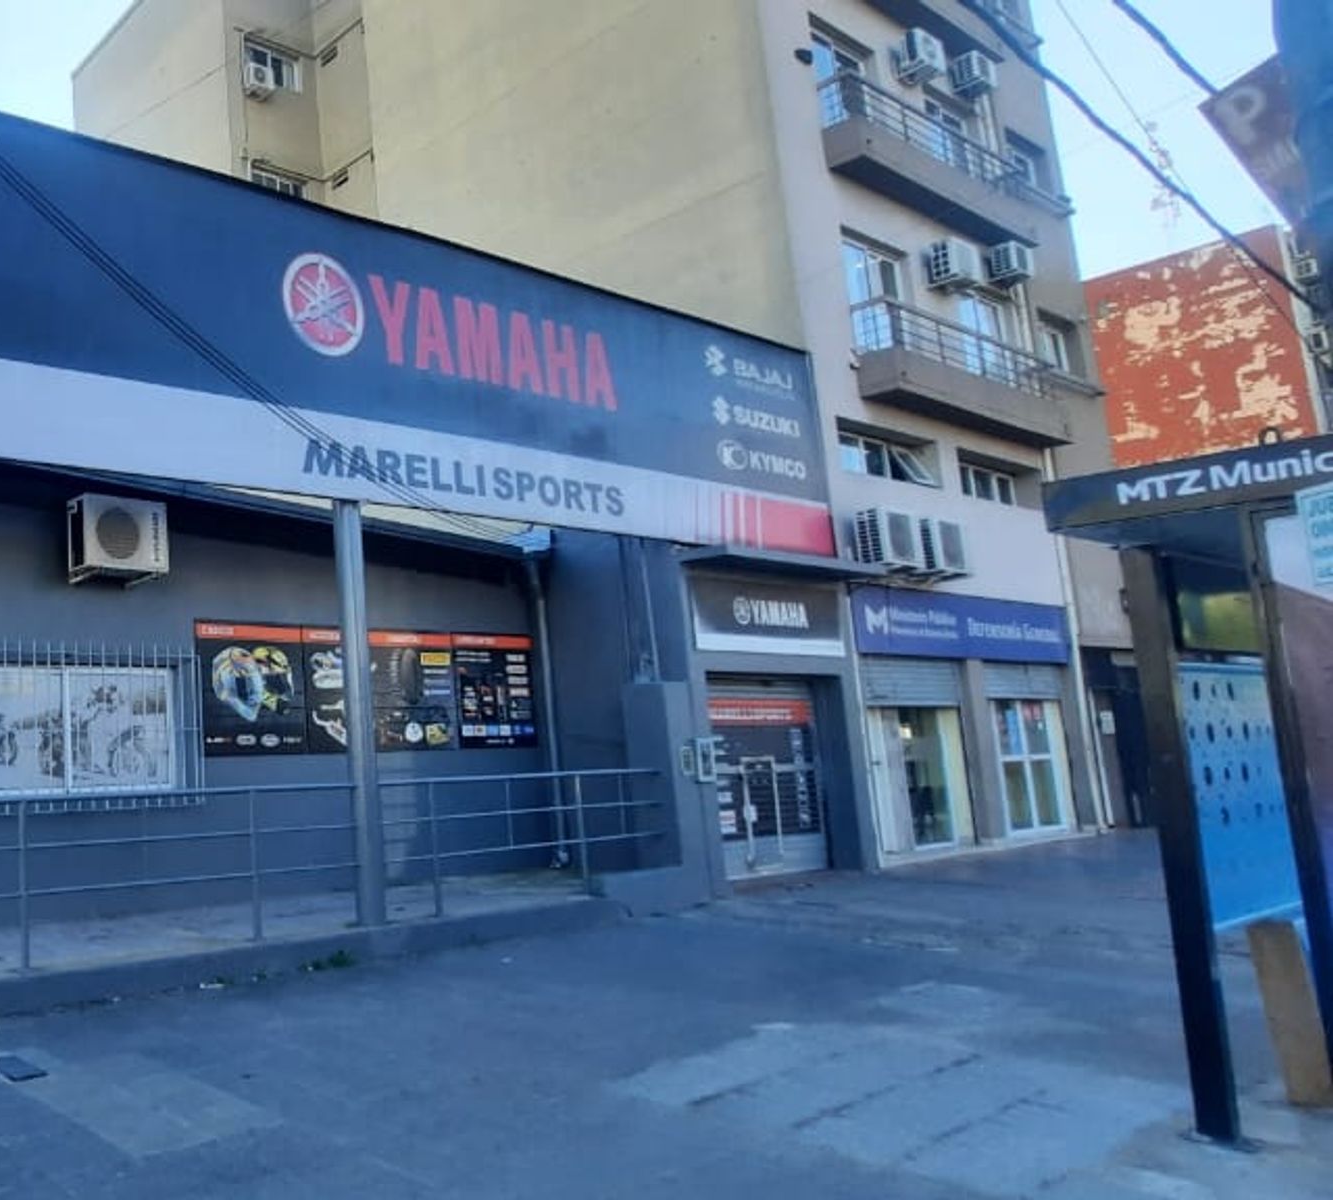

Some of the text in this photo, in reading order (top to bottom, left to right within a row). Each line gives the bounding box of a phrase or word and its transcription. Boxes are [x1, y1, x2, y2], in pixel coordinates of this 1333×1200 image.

[369, 274, 618, 411] YAMAHA
[733, 358, 793, 389] BAJAJ
[733, 405, 801, 438] SUZUKI
[750, 450, 807, 480] KYMCO
[1116, 469, 1207, 505] MTZ
[750, 599, 809, 629] YAMAHA
